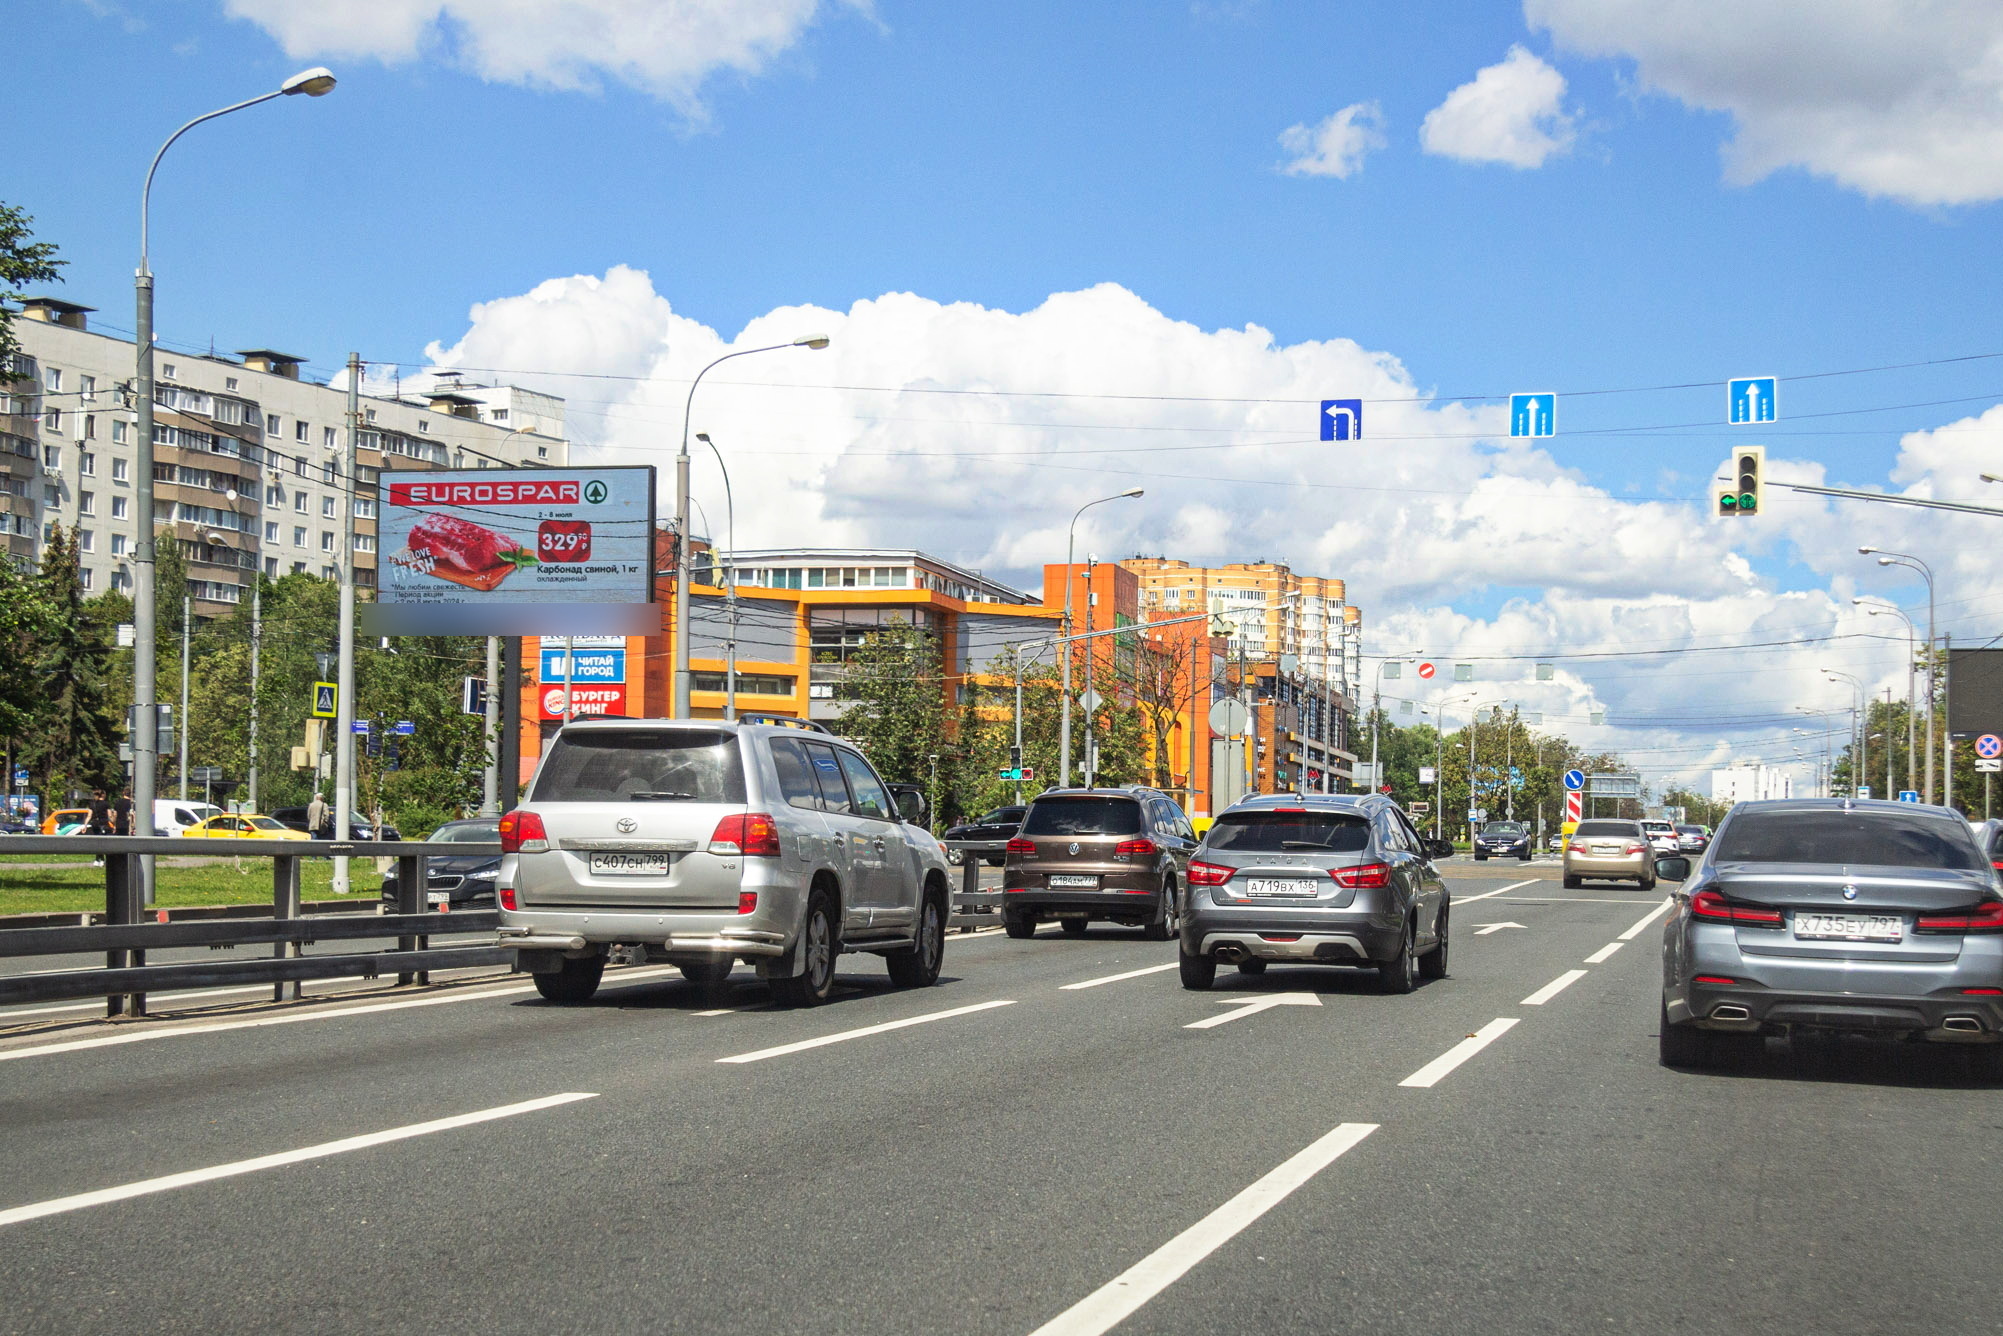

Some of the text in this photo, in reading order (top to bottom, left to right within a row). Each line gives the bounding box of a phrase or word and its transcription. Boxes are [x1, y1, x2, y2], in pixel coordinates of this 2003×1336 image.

[410, 484, 578, 502] EUROSPAR
[542, 533, 578, 550] 329
[411, 547, 432, 561] LOVE
[537, 565, 582, 575] Карбонад
[585, 564, 619, 575] свиной,
[622, 565, 626, 573] 1
[537, 575, 588, 583] охлажденный
[578, 655, 614, 666] ЧИТАЙ
[578, 667, 614, 677] ГОРОД
[572, 691, 620, 701] БУРГЕР
[572, 703, 608, 713] КИНГ
[594, 855, 643, 868] С407СН
[645, 854, 665, 865] 799
[1251, 880, 1314, 892] А719ВХ 136
[1801, 915, 1897, 933] Х735ЕУ 797
